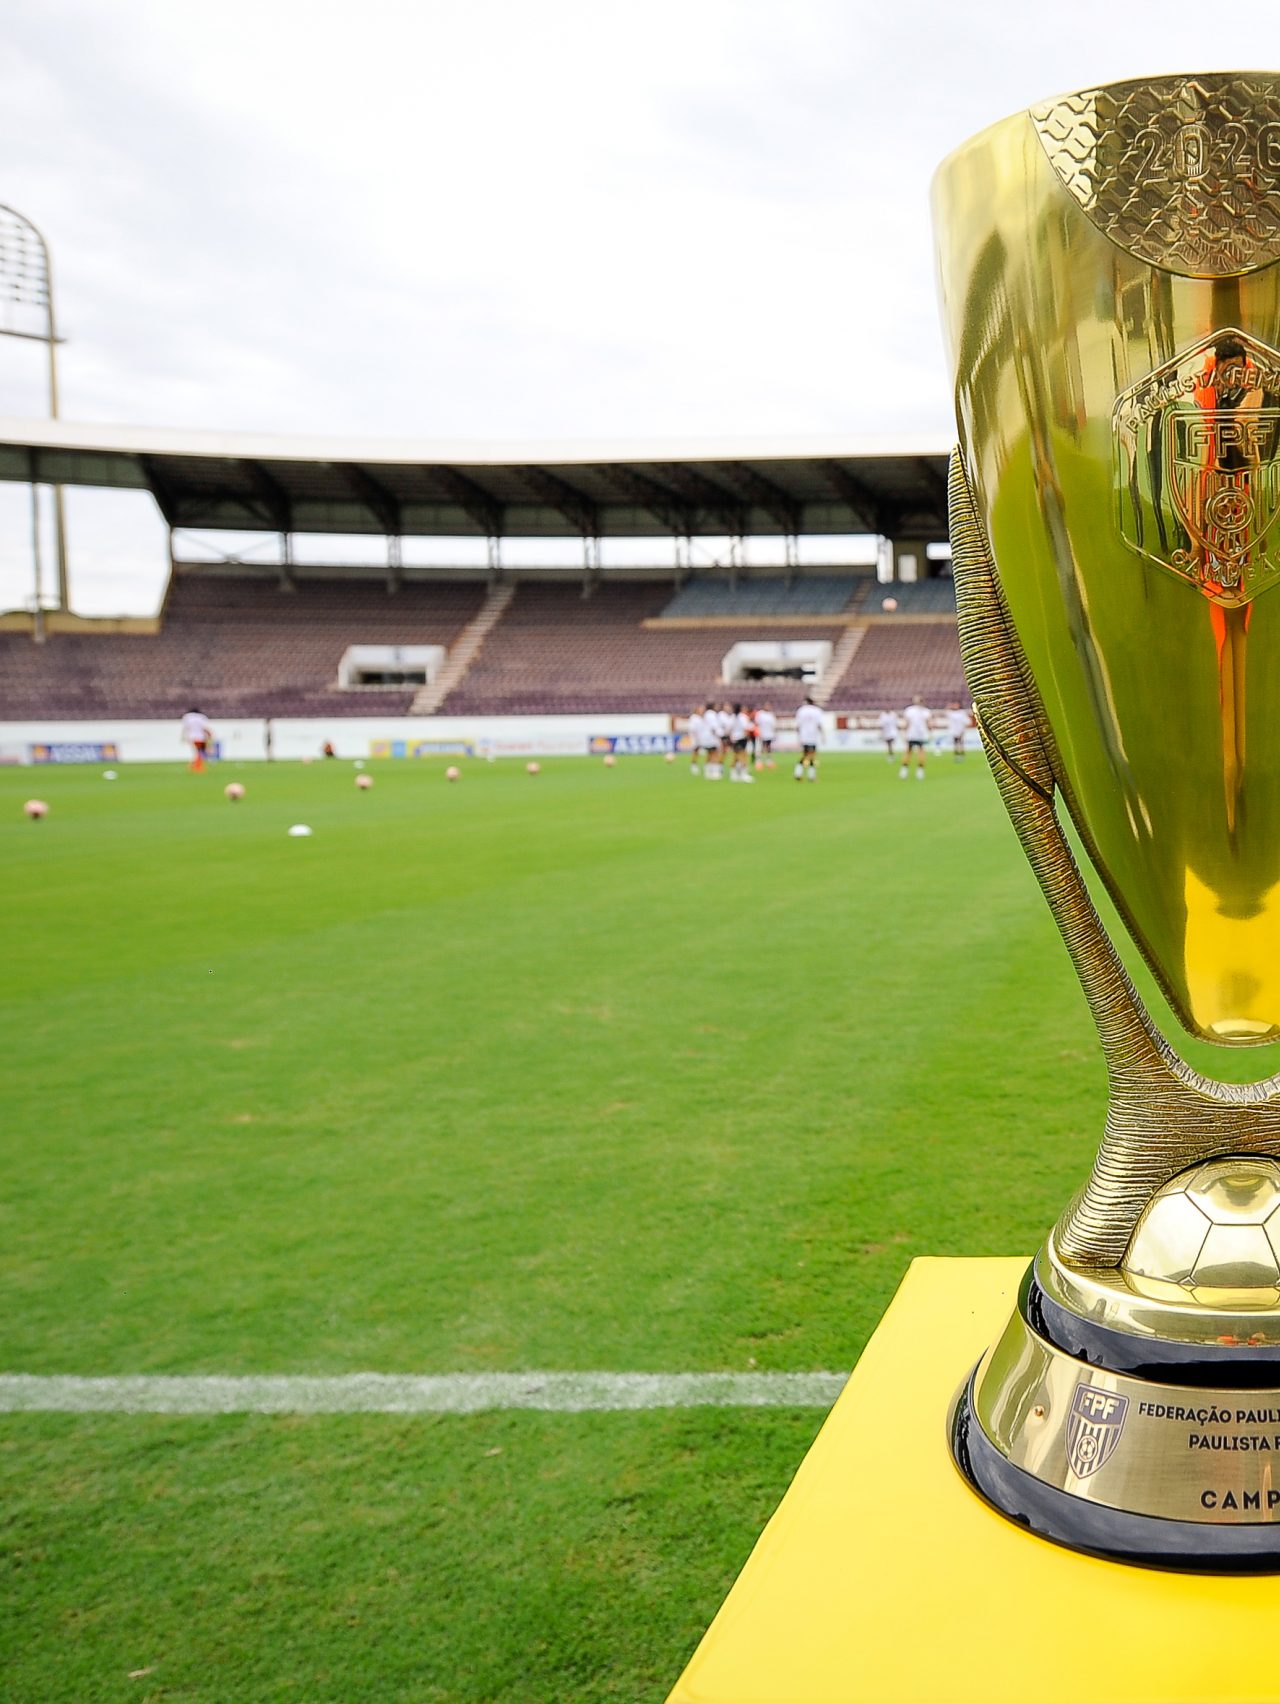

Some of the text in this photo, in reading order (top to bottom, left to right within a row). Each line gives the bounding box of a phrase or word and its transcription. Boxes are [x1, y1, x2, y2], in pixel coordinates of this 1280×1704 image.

[1125, 369, 1224, 434] PAULISTA
[1185, 420, 1274, 459] FPF
[1079, 1391, 1120, 1420] FPF
[1138, 1402, 1232, 1426] FEDERAÇÃO
[1189, 1434, 1271, 1451] PAULISTA
